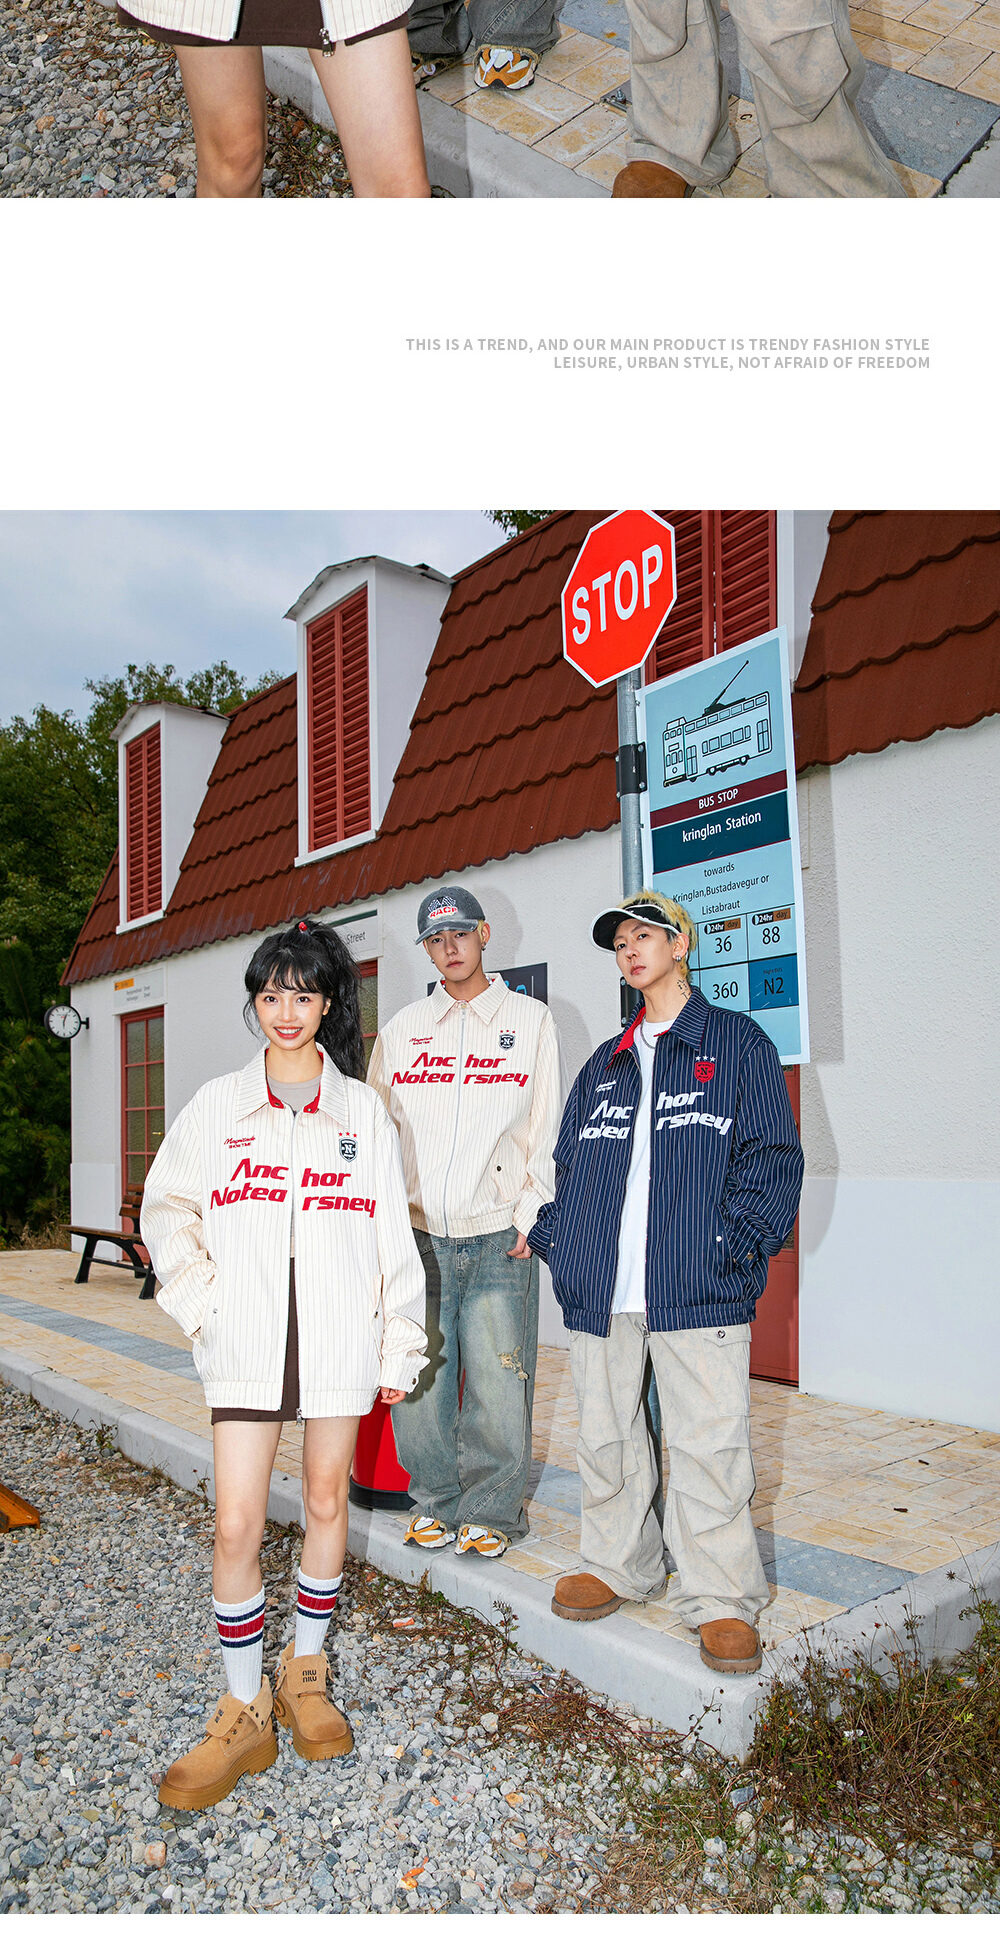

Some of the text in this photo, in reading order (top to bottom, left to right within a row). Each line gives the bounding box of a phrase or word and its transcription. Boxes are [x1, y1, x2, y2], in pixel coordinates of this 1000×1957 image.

[572, 544, 664, 645] STOP
[698, 788, 739, 810] BUS STOP
[682, 812, 762, 843] kringlan Station
[704, 862, 735, 877] towards
[761, 874, 770, 884] or
[701, 900, 741, 915] Listabraut
[759, 910, 788, 923] 24hr day
[710, 920, 739, 932] 24hr day
[762, 926, 781, 945] 88
[347, 931, 366, 945] Street
[715, 935, 732, 954] 36
[712, 981, 739, 1000] 360
[764, 977, 784, 996] N2
[411, 1052, 506, 1068] Anc hor
[391, 1070, 529, 1087] Notea rsney
[590, 1091, 705, 1120] Anc hor
[655, 1112, 733, 1135] rsney
[230, 1158, 351, 1187] Anc hor
[210, 1182, 376, 1218] Notea rsney
